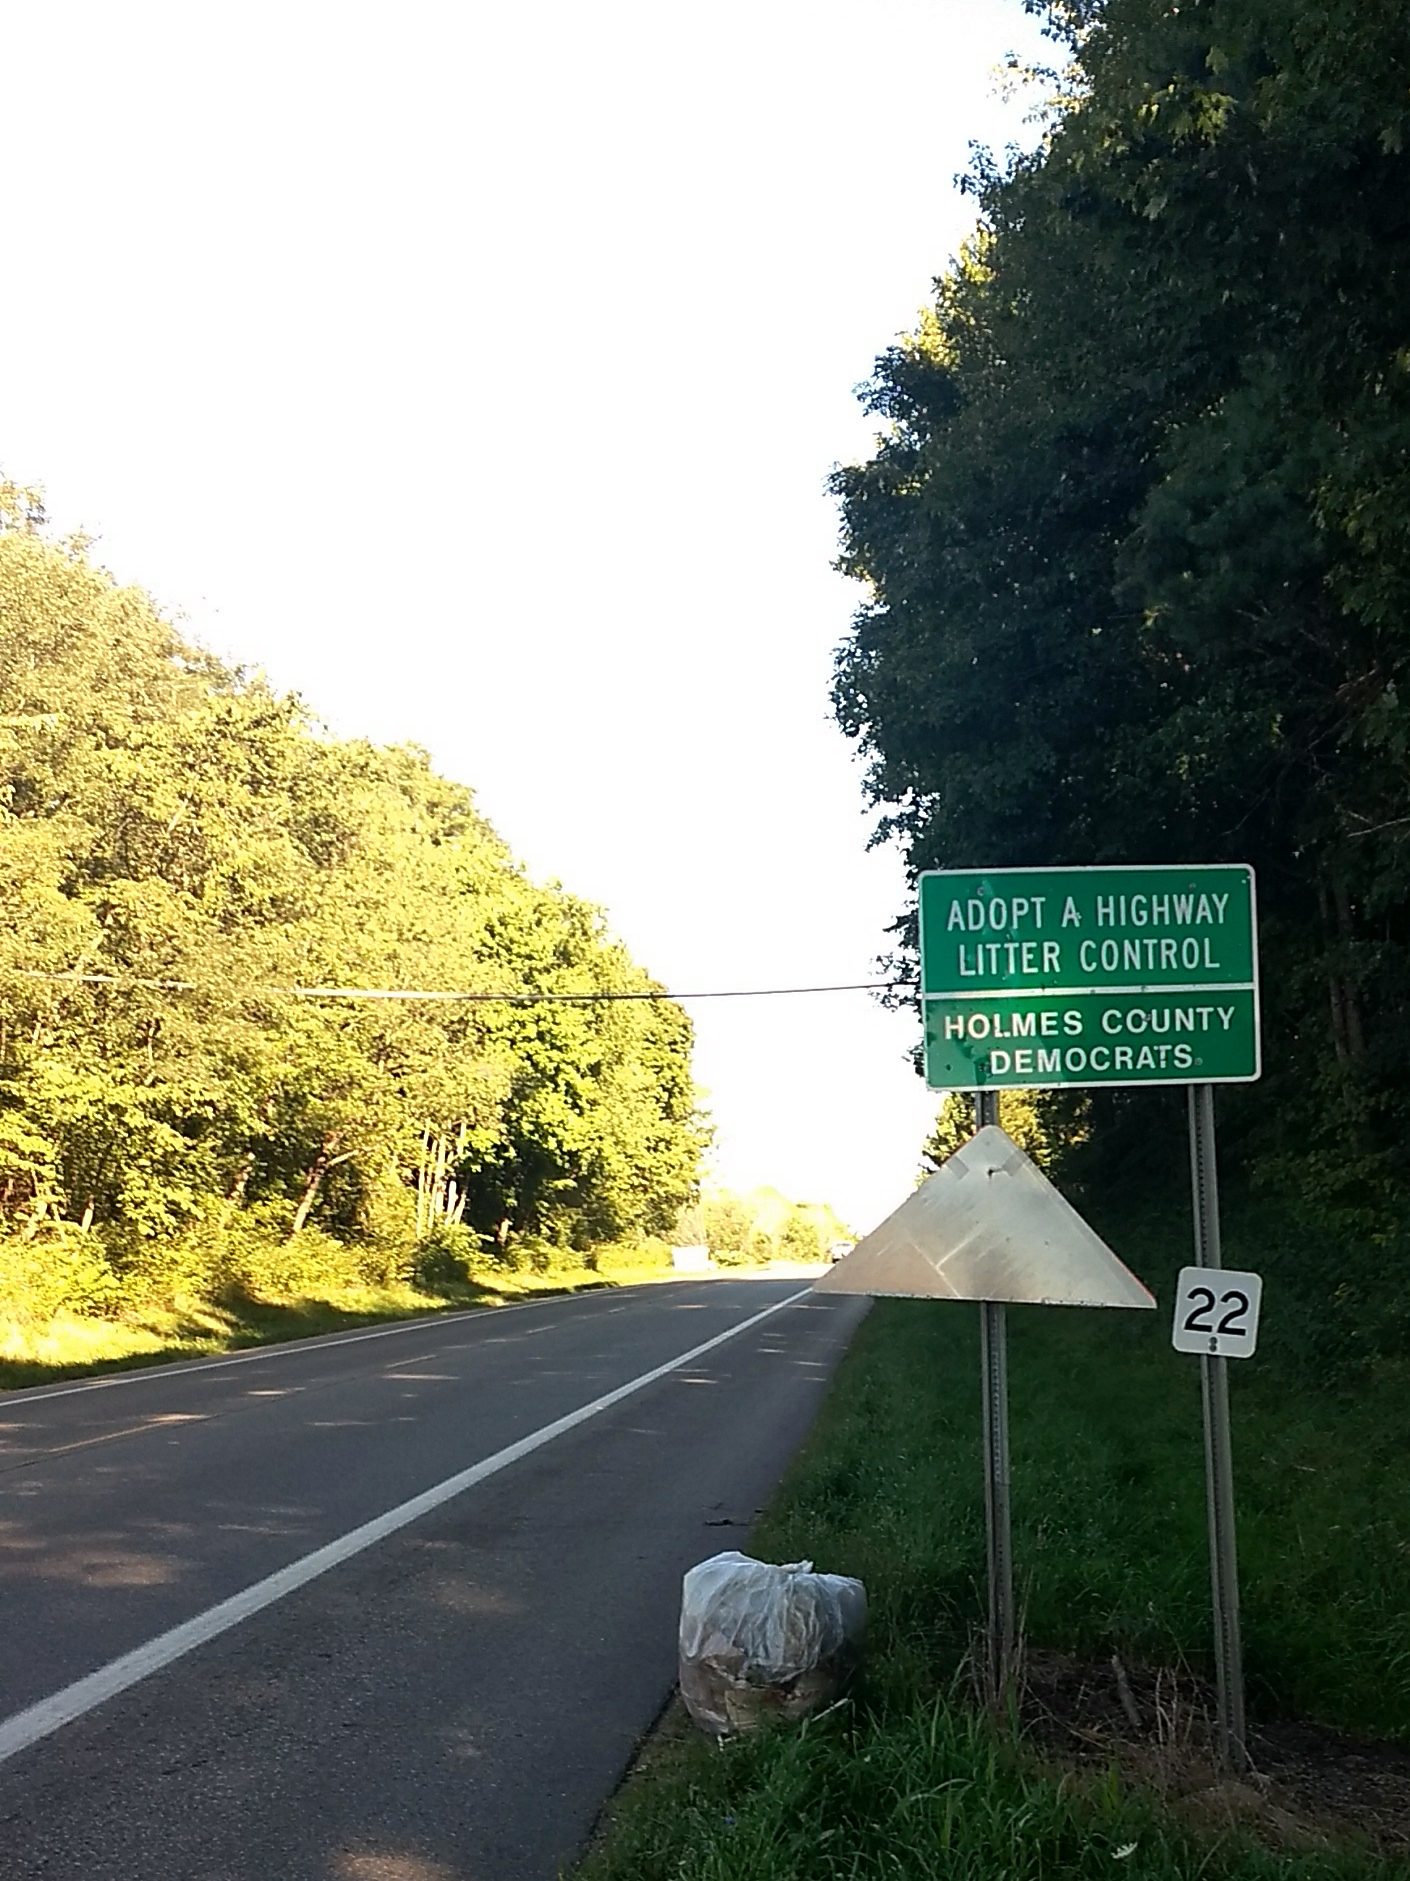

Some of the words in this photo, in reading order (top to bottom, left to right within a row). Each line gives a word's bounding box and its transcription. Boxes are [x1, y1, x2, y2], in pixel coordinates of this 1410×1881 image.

[947, 896, 1046, 931] ADOPT
[1061, 896, 1082, 928] A
[1097, 893, 1230, 926] HIGHWAY
[959, 941, 1061, 976] LITTER
[1080, 937, 1220, 972] CONTROL
[944, 1010, 1083, 1040] HOLMES
[1101, 1006, 1235, 1034] COUNTY
[990, 1044, 1193, 1075] DEMOCRATS
[1184, 1287, 1249, 1336] 22
